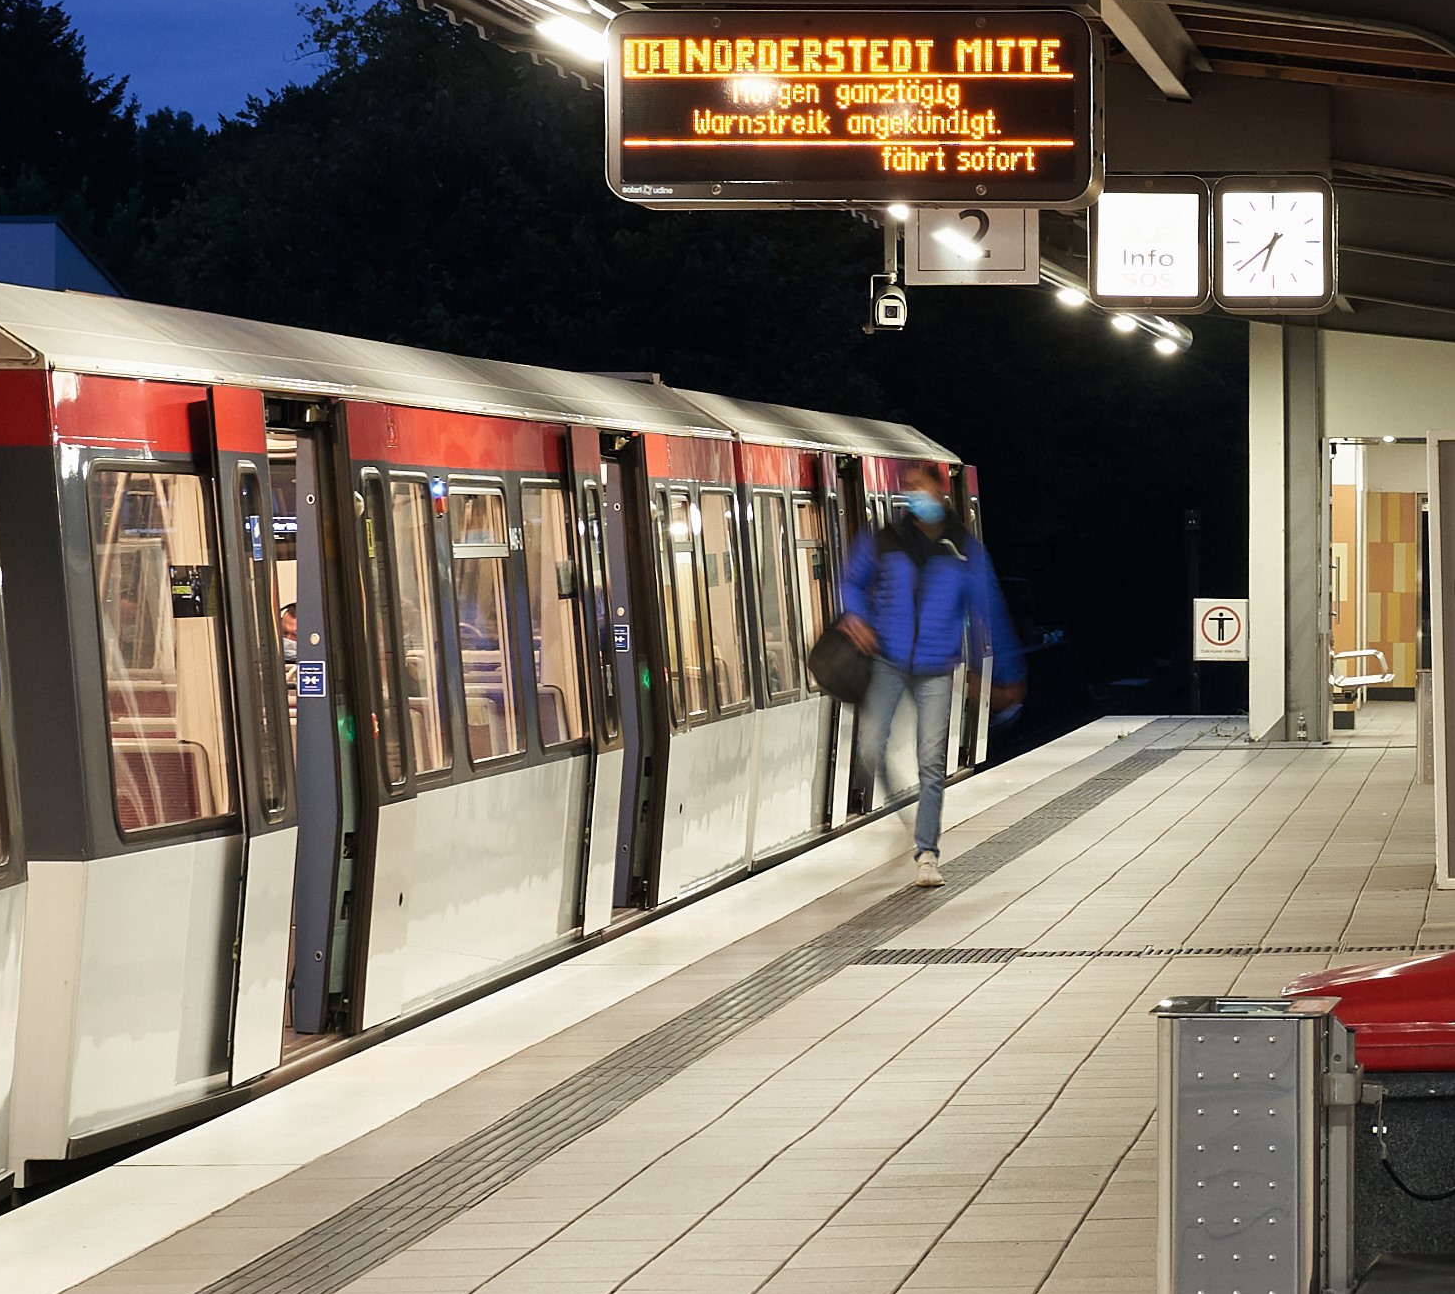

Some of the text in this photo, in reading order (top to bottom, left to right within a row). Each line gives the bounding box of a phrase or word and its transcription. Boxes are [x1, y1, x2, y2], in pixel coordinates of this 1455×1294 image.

[631, 39, 1060, 75] U1 NORDERSTEDT MITTE
[835, 78, 960, 109] ganztägig
[694, 108, 1002, 140] Warnstreik angekündigt.
[881, 146, 1036, 172] fährt sofort
[956, 208, 991, 259] 2
[1123, 249, 1175, 267] Info
